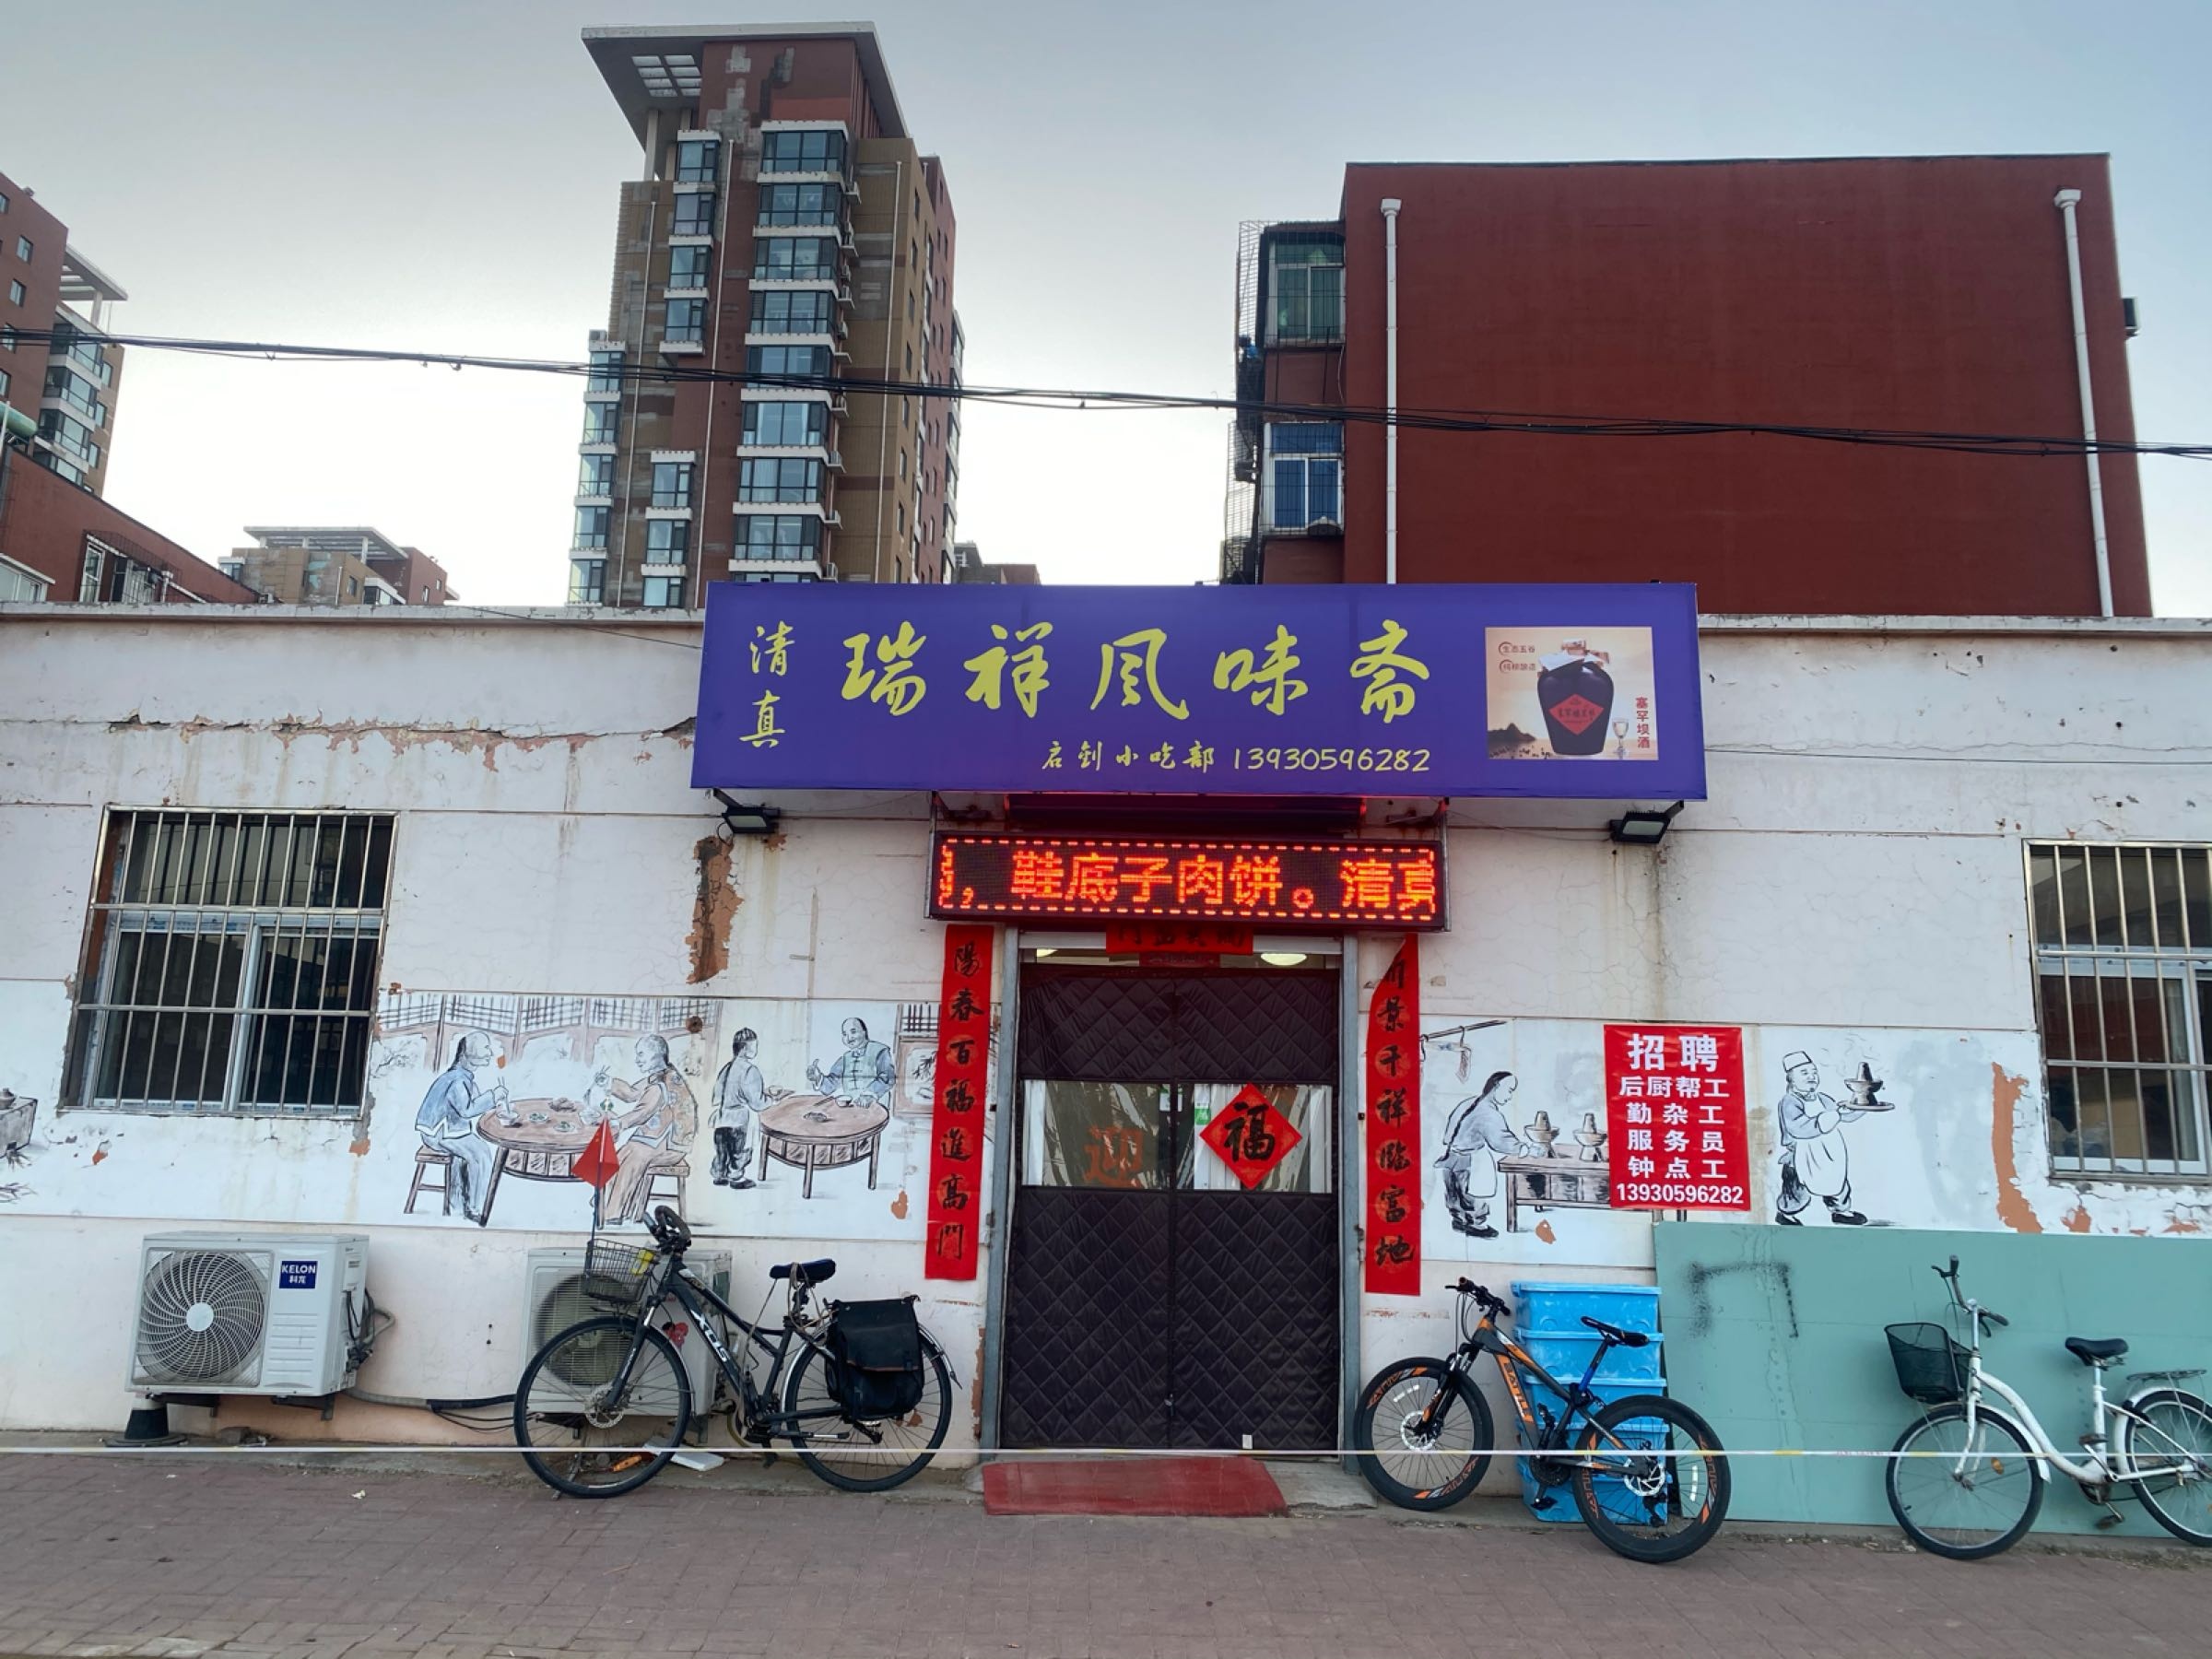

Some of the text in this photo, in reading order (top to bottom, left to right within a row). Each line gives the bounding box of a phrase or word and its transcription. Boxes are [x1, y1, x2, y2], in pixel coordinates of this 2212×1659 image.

[841, 618, 1430, 723] 瑞祥风味斋
[740, 620, 794, 748] 清真
[1635, 696, 1651, 749] 塞罕坝酒
[1234, 747, 1430, 772] 13930596282
[1628, 1033, 1719, 1073] 招聘
[1619, 1076, 1730, 1099] 后厨帮工
[1626, 1102, 1725, 1125] 勤杂工
[1223, 1101, 1276, 1162] 福
[1627, 1129, 1725, 1153] 服务员
[1628, 1156, 1728, 1180] 钟点工
[1617, 1182, 1745, 1205] 13930596282
[281, 1264, 316, 1275] KELON
